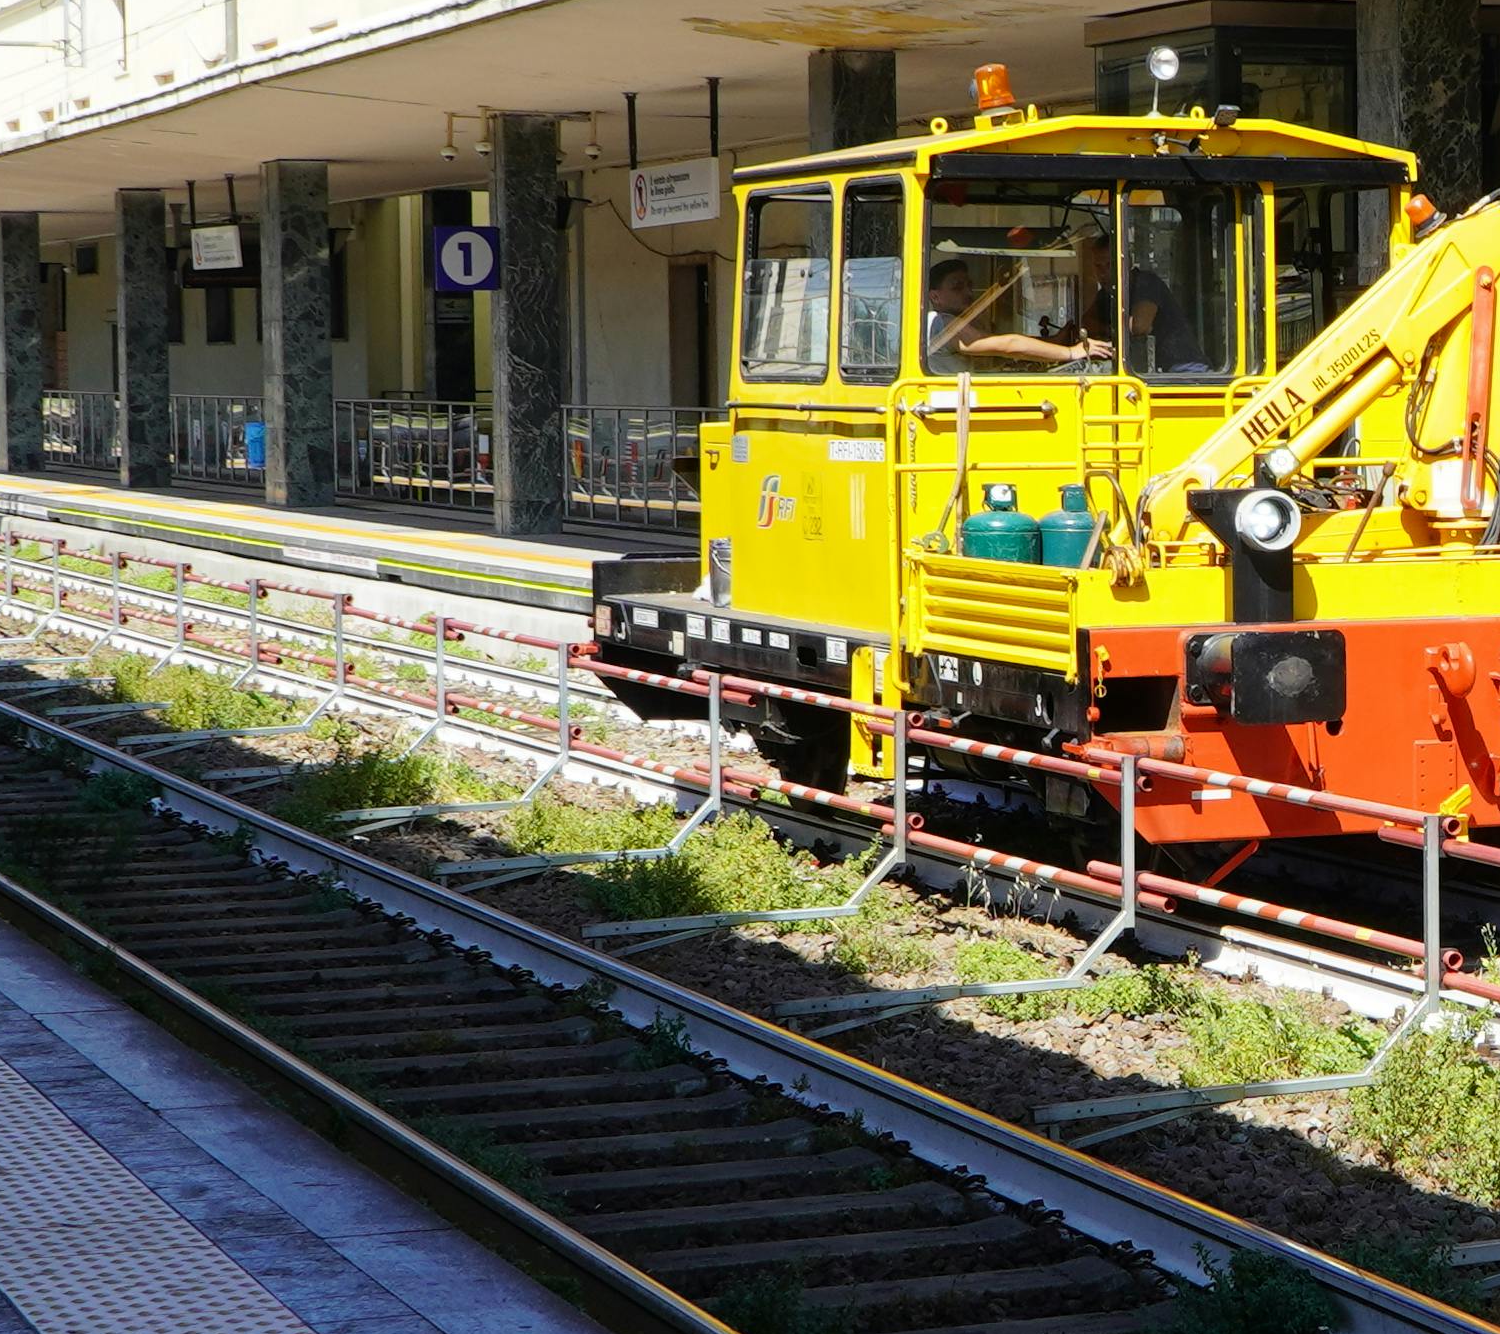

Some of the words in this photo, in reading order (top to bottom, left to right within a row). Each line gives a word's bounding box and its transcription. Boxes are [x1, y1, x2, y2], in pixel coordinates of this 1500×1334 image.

[457, 242, 473, 276] 1
[1312, 375, 1331, 392] HL
[1240, 386, 1306, 447] HEILA
[777, 497, 795, 522] RFI
